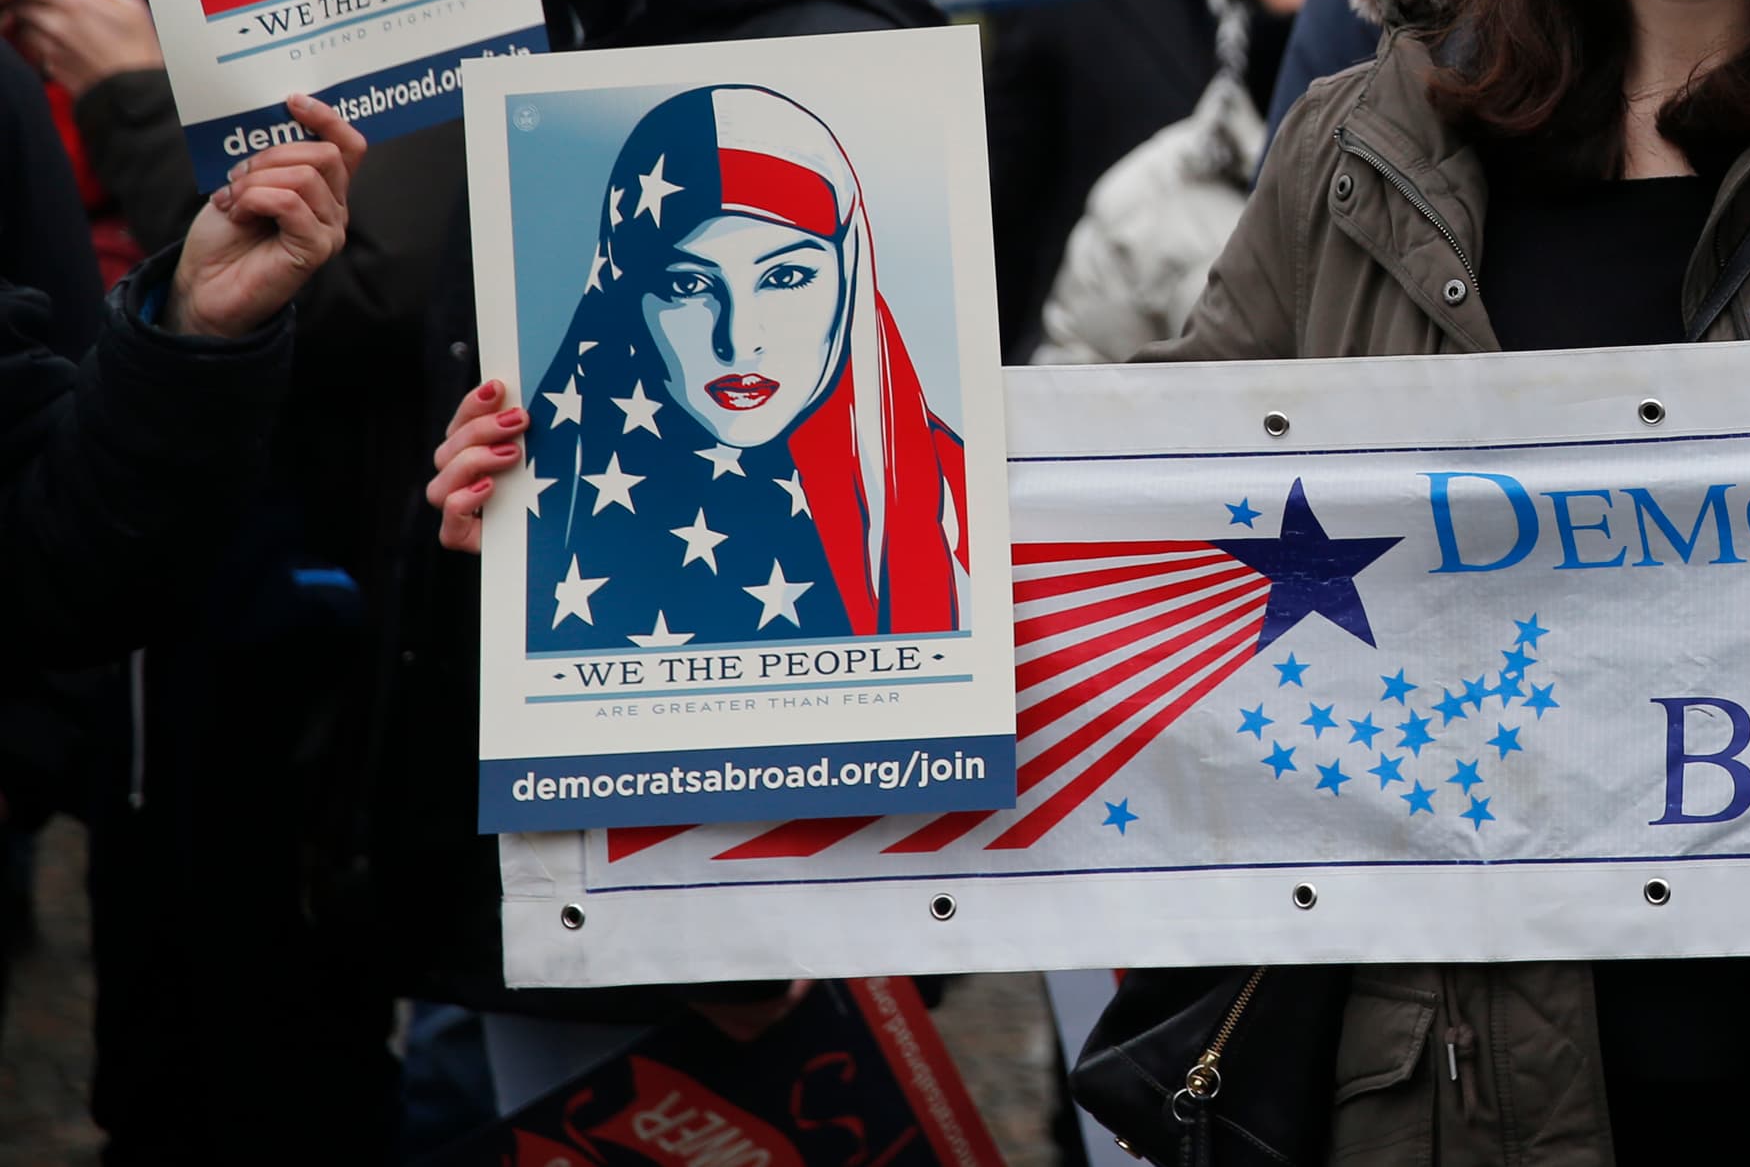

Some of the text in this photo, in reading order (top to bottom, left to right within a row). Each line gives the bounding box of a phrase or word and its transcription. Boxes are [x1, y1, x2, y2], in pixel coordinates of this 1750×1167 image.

[256, 2, 315, 36] WE
[289, 0, 470, 61] DEFEND DIGNITY
[574, 645, 922, 688] WE THE PEOPLE
[595, 690, 901, 719] ARE GREATER THAN FEAR
[511, 749, 986, 802] democratsabroad.org/join
[632, 1090, 775, 1167] OWER
